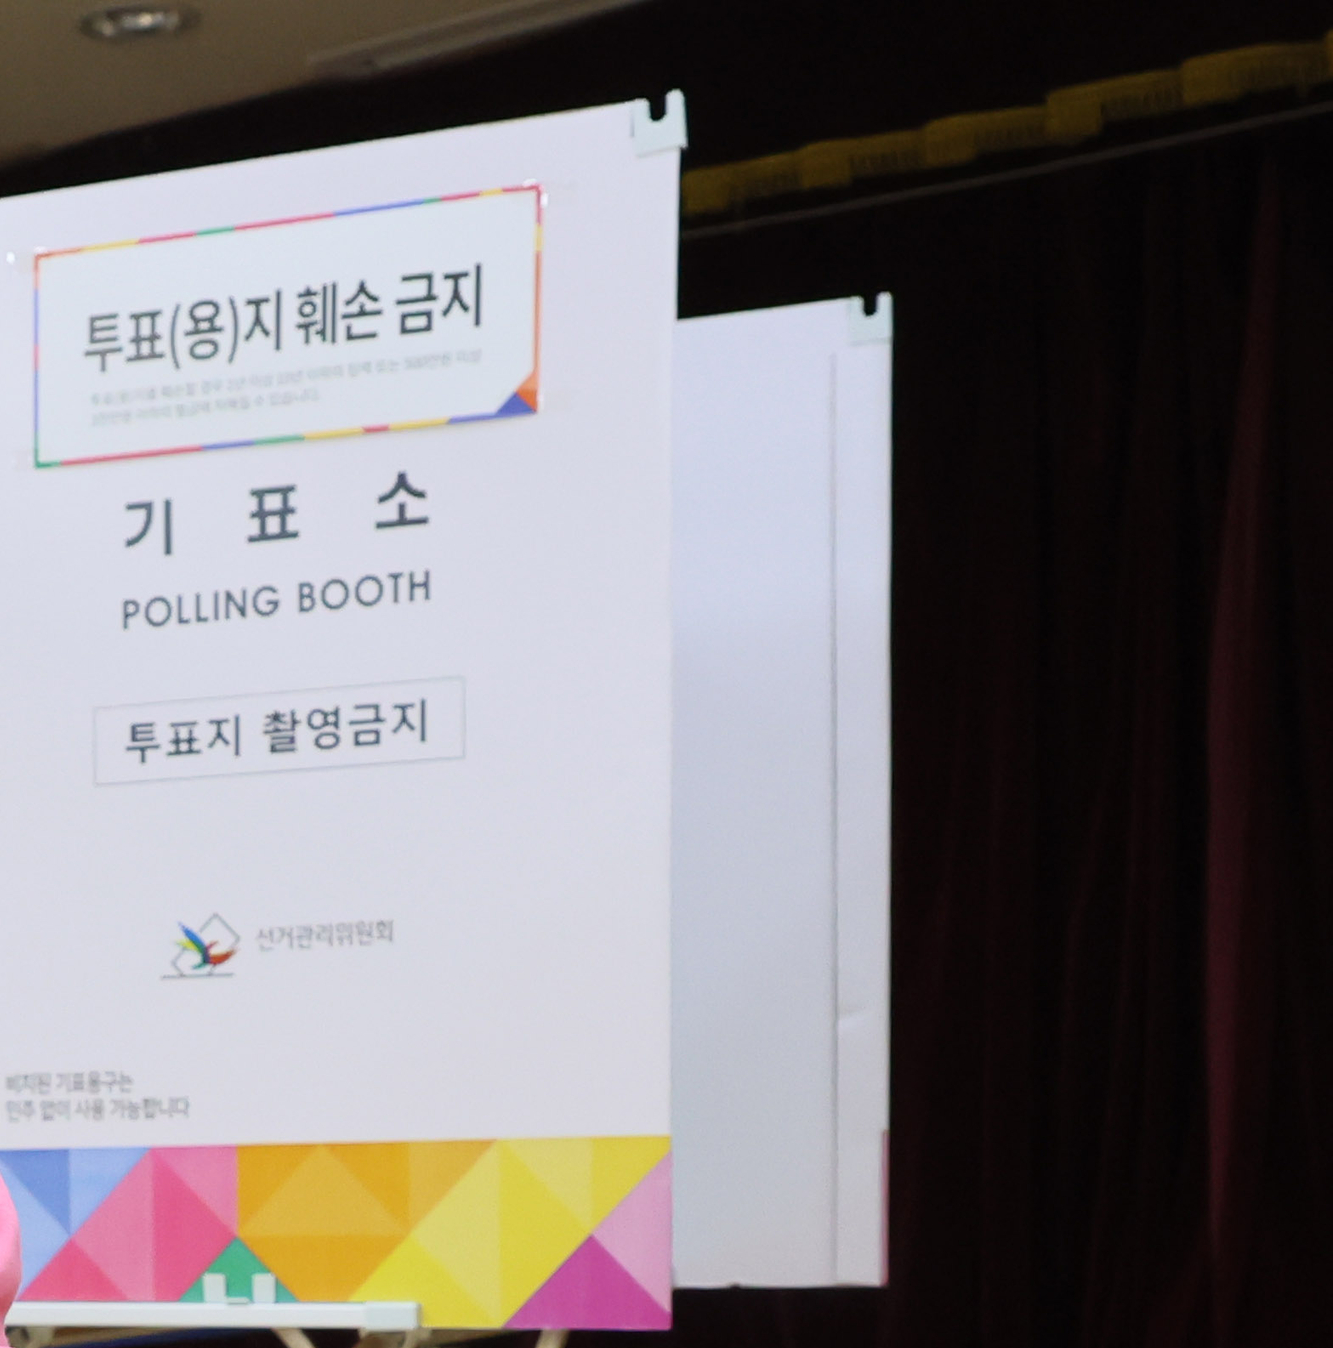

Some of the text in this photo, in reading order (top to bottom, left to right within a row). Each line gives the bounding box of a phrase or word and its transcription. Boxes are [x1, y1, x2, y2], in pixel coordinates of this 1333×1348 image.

[83, 262, 484, 374] 투표(용)지 훼손 금지
[121, 568, 433, 632] POLLING BOOTH
[124, 696, 429, 766] 투표지 촬영금지
[254, 917, 396, 953] 선거관리위원회
